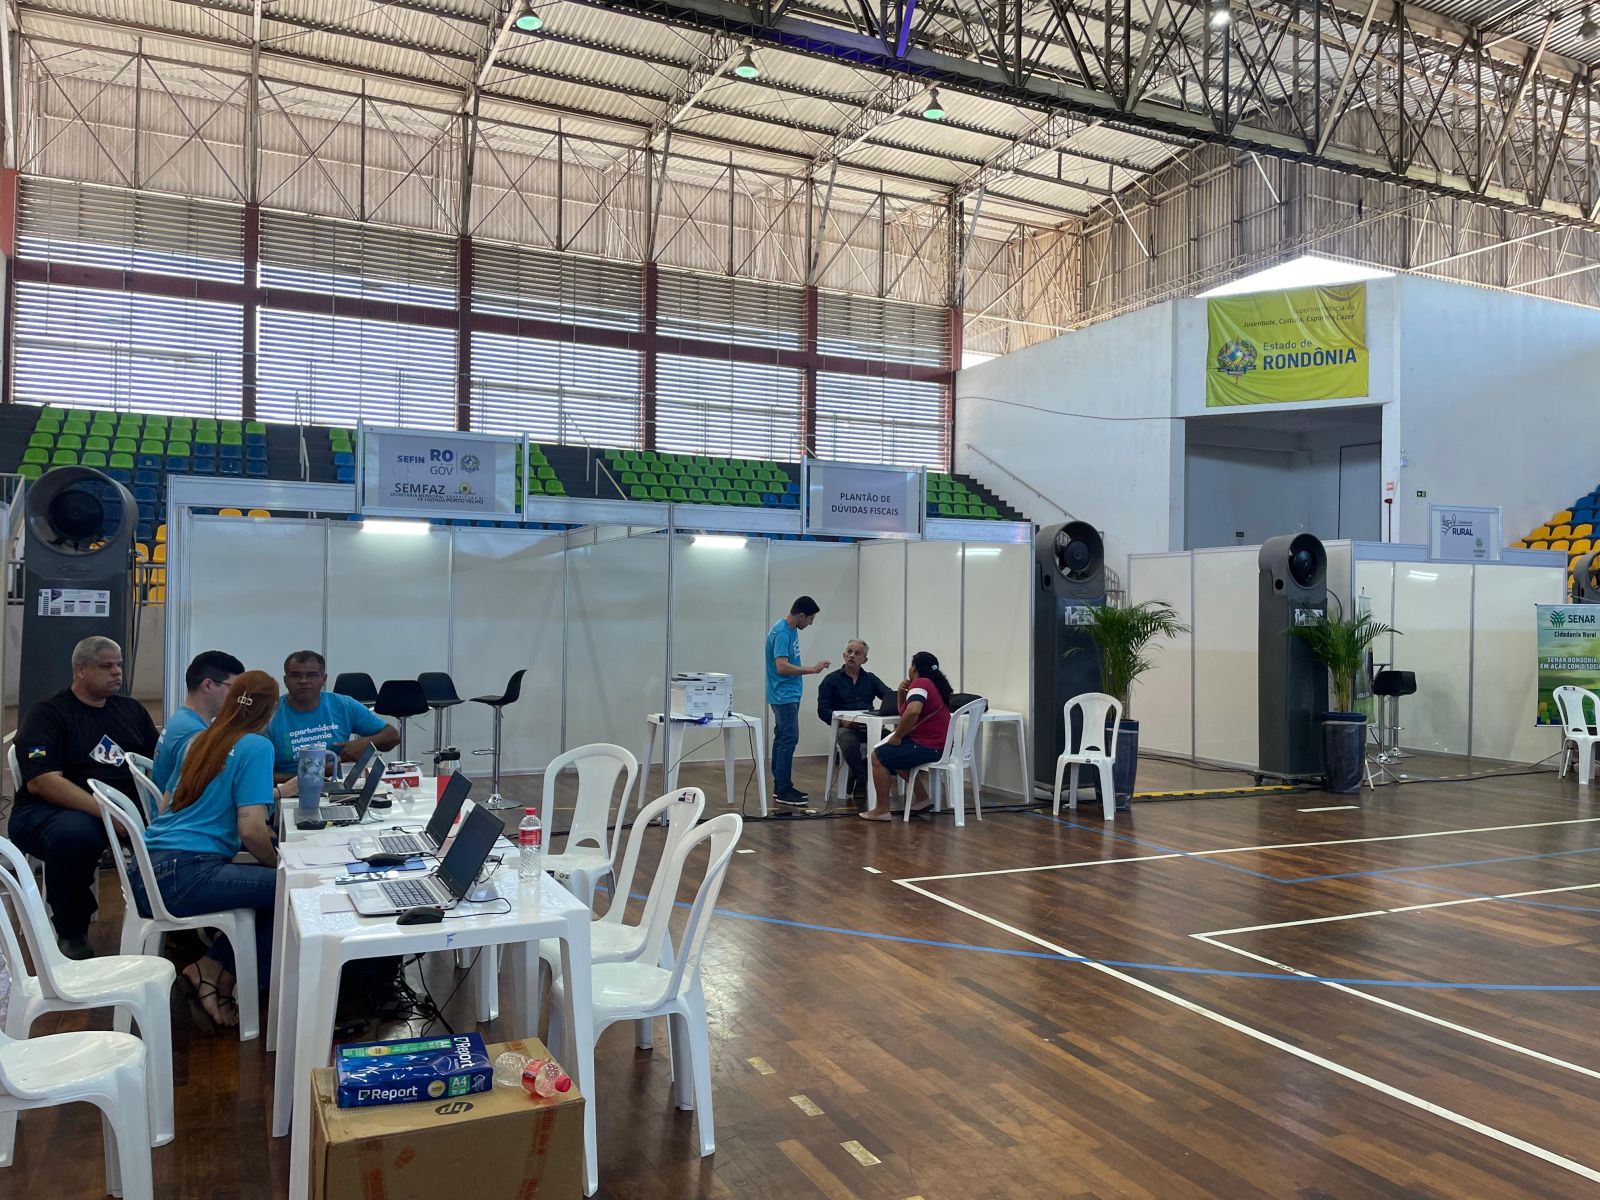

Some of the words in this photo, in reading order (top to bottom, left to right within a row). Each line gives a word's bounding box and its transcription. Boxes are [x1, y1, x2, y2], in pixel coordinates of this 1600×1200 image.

[1243, 319, 1277, 328] Juventude,
[1263, 340, 1297, 351] Estado
[1300, 338, 1313, 348] de
[1263, 347, 1357, 370] RONDÔNIA
[397, 455, 425, 463] SEFIN
[430, 449, 453, 461] RO
[430, 466, 453, 475] GOV
[394, 482, 446, 495] SEMFAZ
[840, 492, 879, 502] PLANTÃO
[880, 495, 891, 503] DE
[831, 504, 868, 514] DÚVIDAS
[870, 507, 899, 516] FISCAIS
[1452, 527, 1473, 536] RURAL
[1567, 614, 1596, 624] SENAR
[289, 722, 339, 737] oportunidade
[291, 732, 333, 745] autonomia
[455, 1042, 476, 1069] Report
[452, 1076, 468, 1087] A4
[371, 1085, 418, 1101] Report
